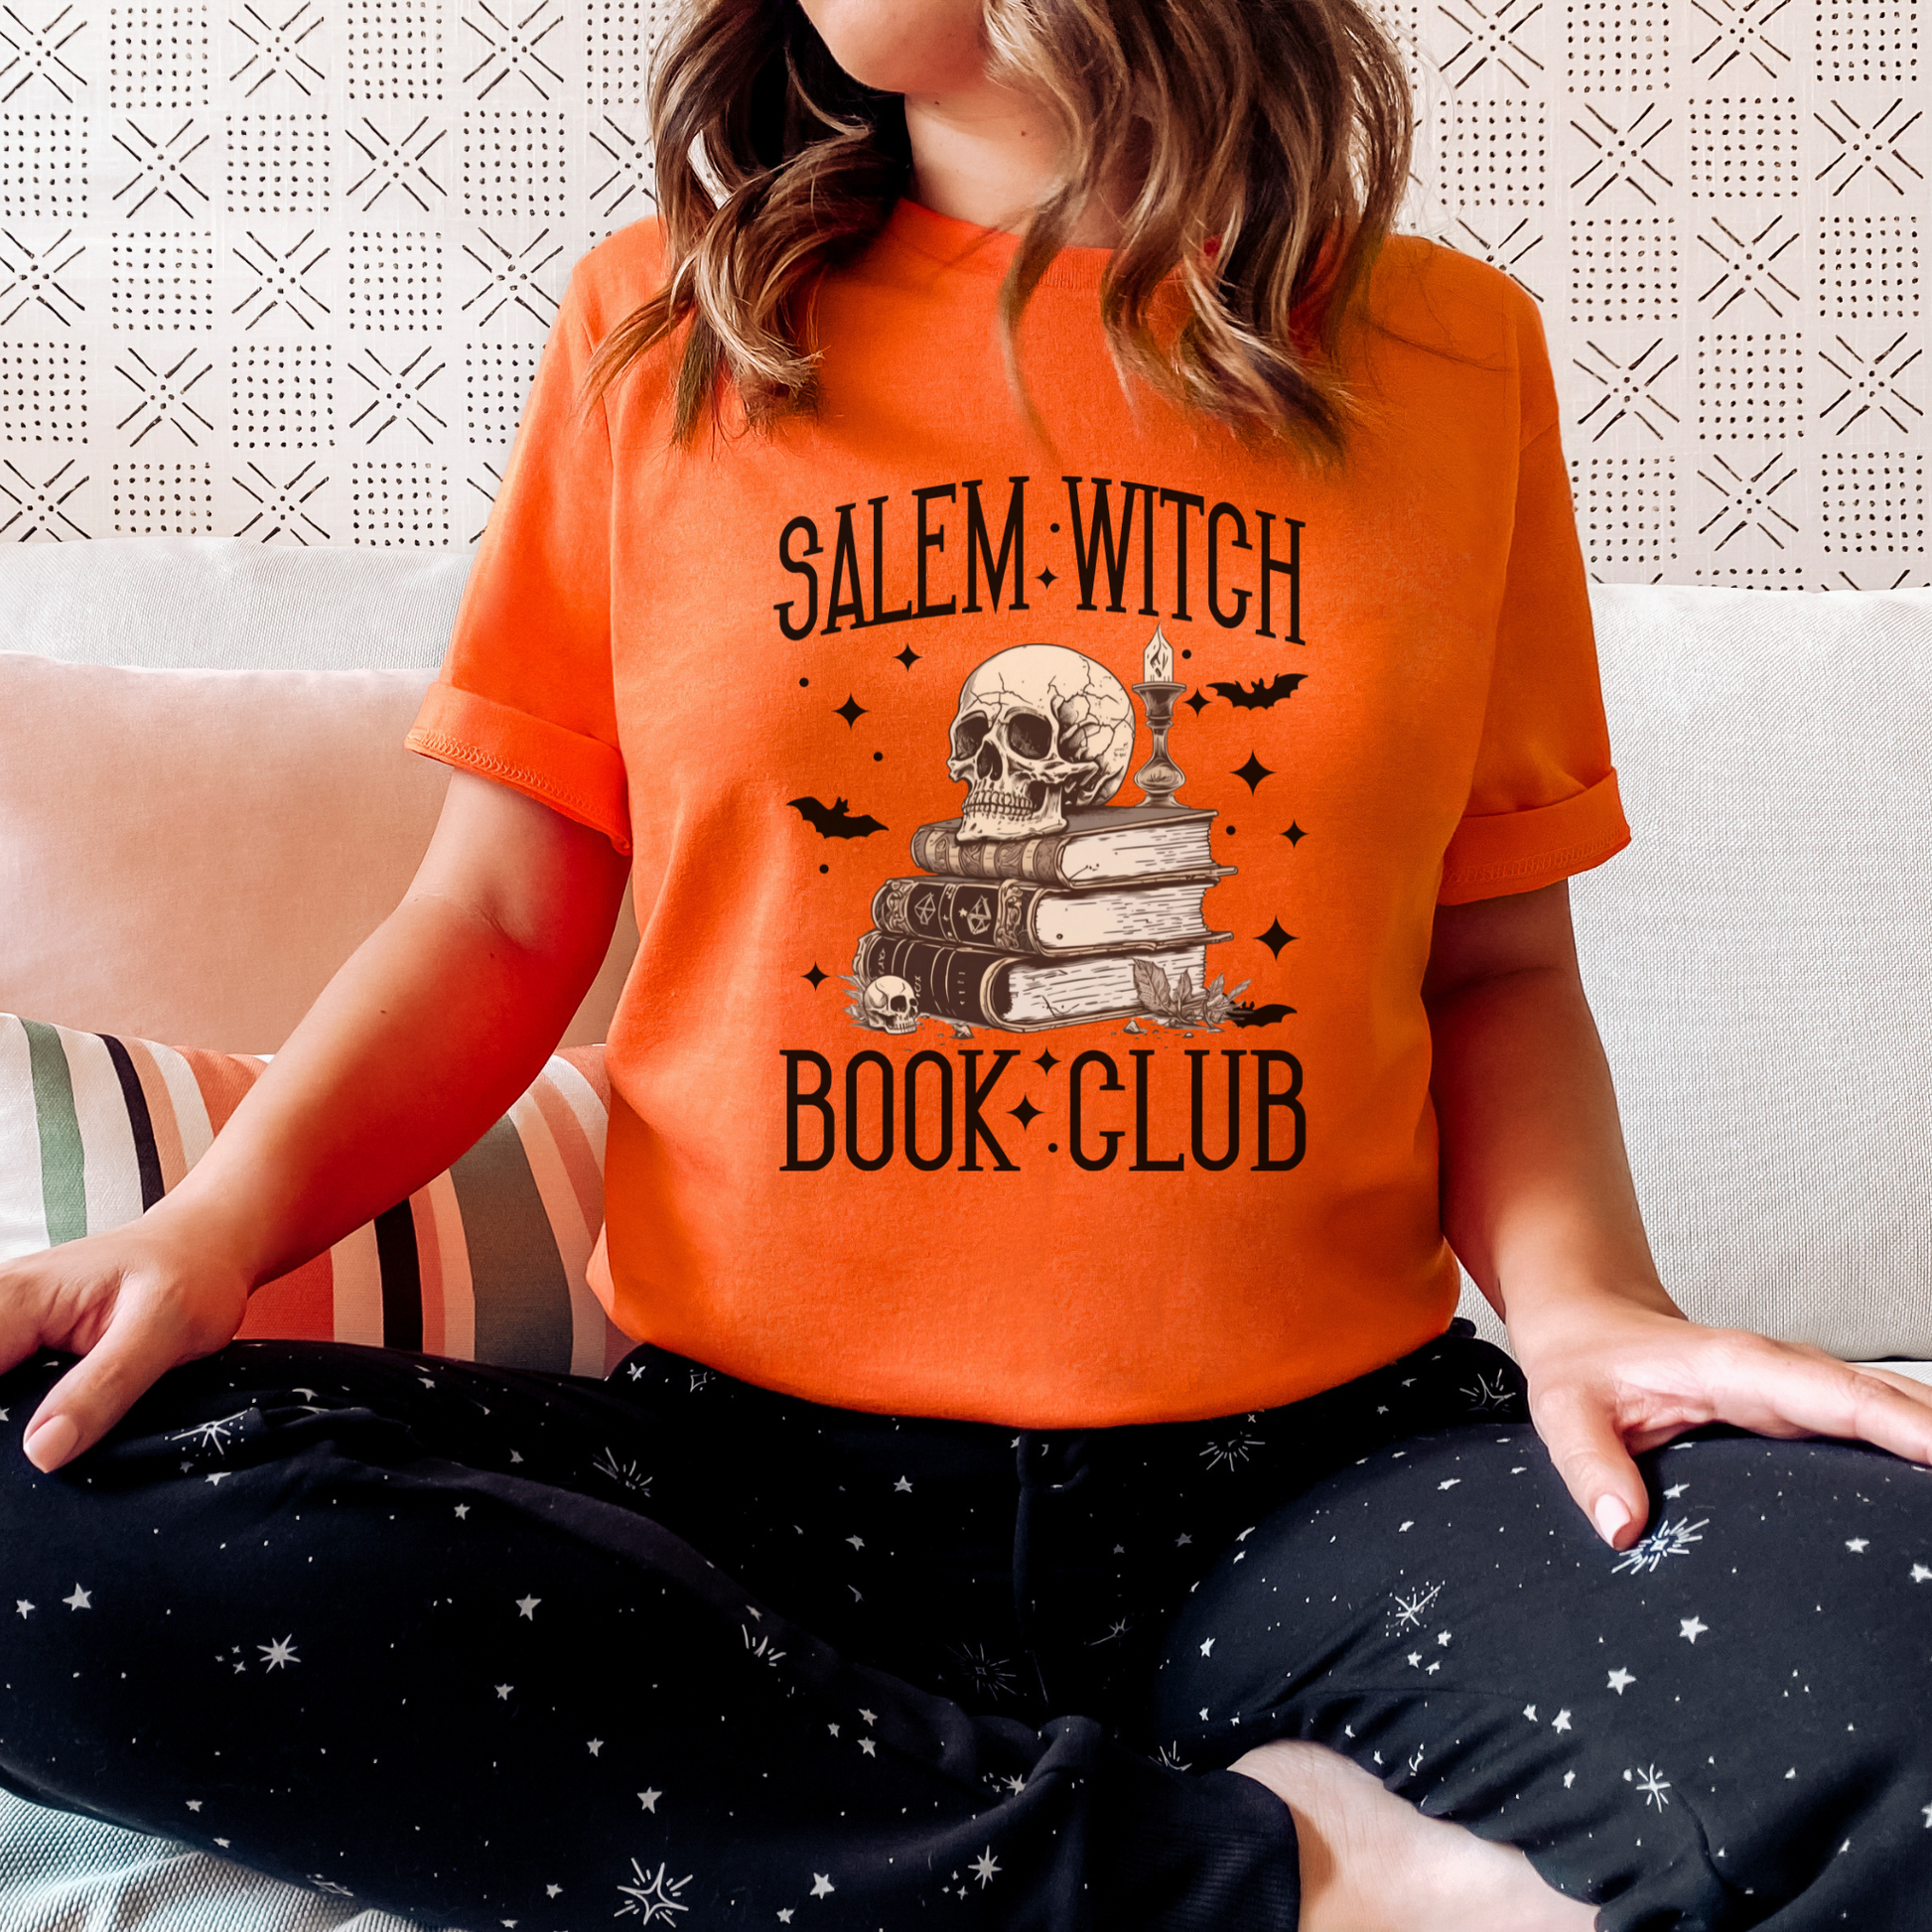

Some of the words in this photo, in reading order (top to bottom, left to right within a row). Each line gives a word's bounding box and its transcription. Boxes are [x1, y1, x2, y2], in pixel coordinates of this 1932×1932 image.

[773, 476, 1030, 641] SALEM
[1061, 476, 1307, 646] WITCH
[778, 1049, 1022, 1172] BOOK
[1069, 1049, 1307, 1172] CLUB
